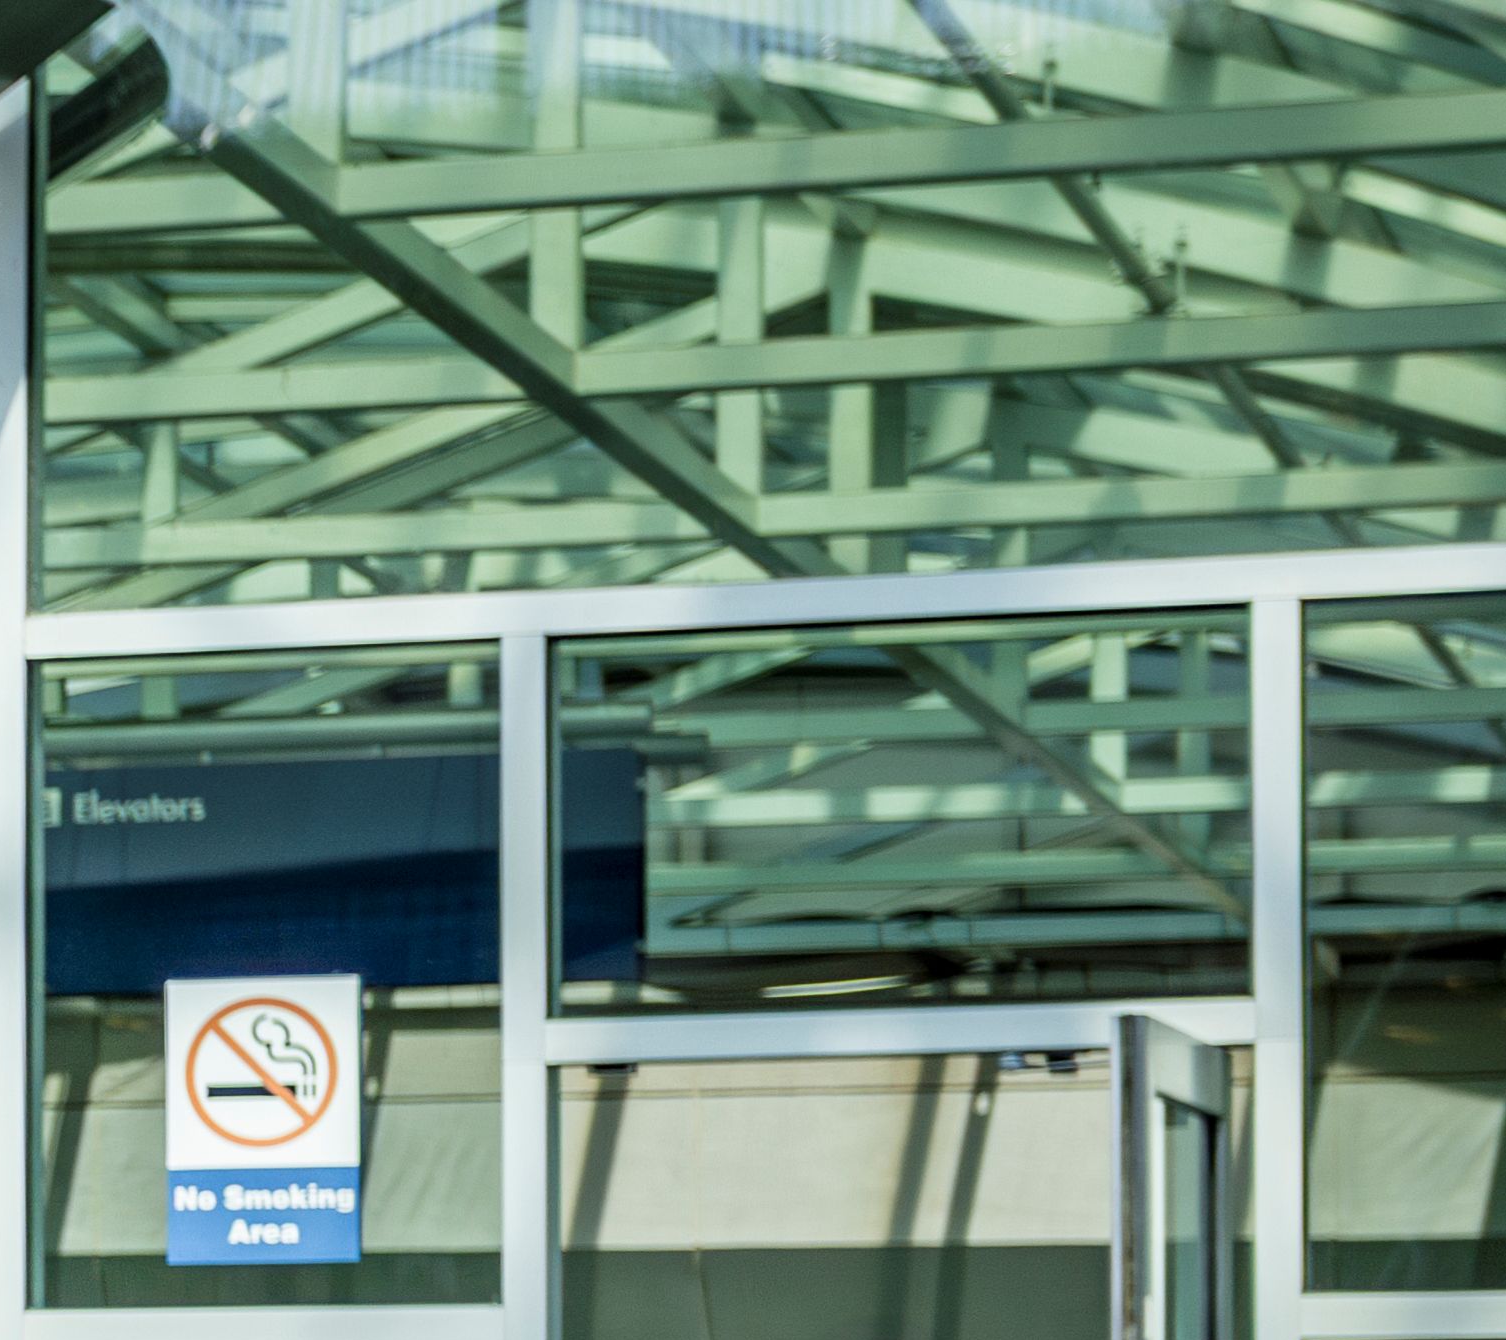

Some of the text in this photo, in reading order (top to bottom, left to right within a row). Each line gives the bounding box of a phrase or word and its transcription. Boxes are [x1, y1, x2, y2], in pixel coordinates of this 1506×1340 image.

[74, 788, 207, 825] Elevators
[173, 1182, 356, 1215] No Smoking
[227, 1218, 301, 1246] Area
